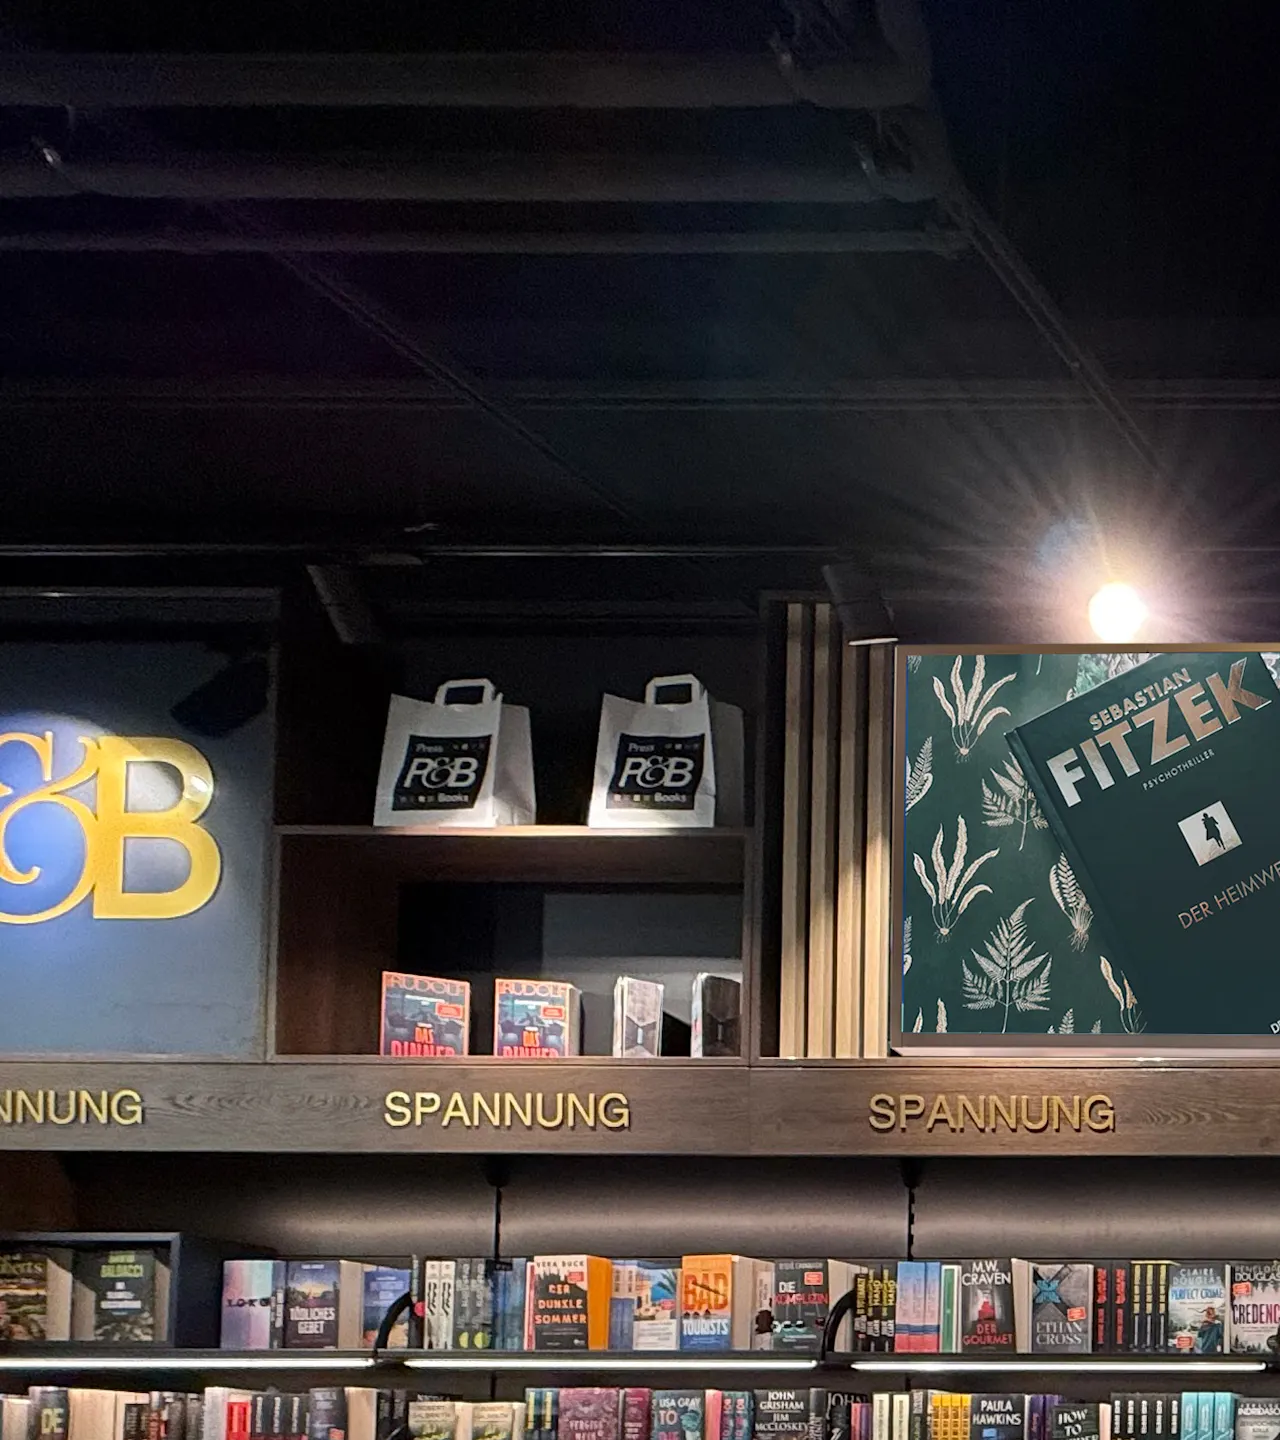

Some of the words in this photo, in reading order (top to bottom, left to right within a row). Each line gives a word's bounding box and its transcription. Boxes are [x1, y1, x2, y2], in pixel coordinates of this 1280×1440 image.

[1088, 667, 1193, 733] SEBASTIAN
[1045, 657, 1272, 808] FITZEK
[404, 754, 478, 788] P&B
[618, 756, 695, 788] P&B
[1141, 748, 1215, 791] PSYCHOTHRILLER
[1178, 901, 1213, 929] DER
[383, 1091, 631, 1130] SPANNUNG
[868, 1095, 1116, 1133] SPANNUNG
[972, 1261, 998, 1273] M.W.
[961, 1272, 1011, 1286] CRAVEN
[683, 1274, 728, 1310] BAD
[779, 1282, 796, 1293] DIE
[538, 1300, 583, 1310] DUNKLE
[534, 1315, 586, 1325] SOMMER
[682, 1319, 728, 1335] TOURISTS
[976, 1324, 997, 1334] DER
[1036, 1321, 1082, 1333] ETHAN
[963, 1333, 1013, 1345] GOURMET
[1036, 1333, 1082, 1345] CROSS
[768, 1391, 796, 1401] JOHN
[759, 1400, 805, 1410] GRISHAM
[981, 1400, 1013, 1411] PAULA
[773, 1413, 790, 1422] JIM
[972, 1413, 1022, 1425] HAWKINS
[1058, 1409, 1089, 1425] HOW
[1065, 1423, 1082, 1436] TO
